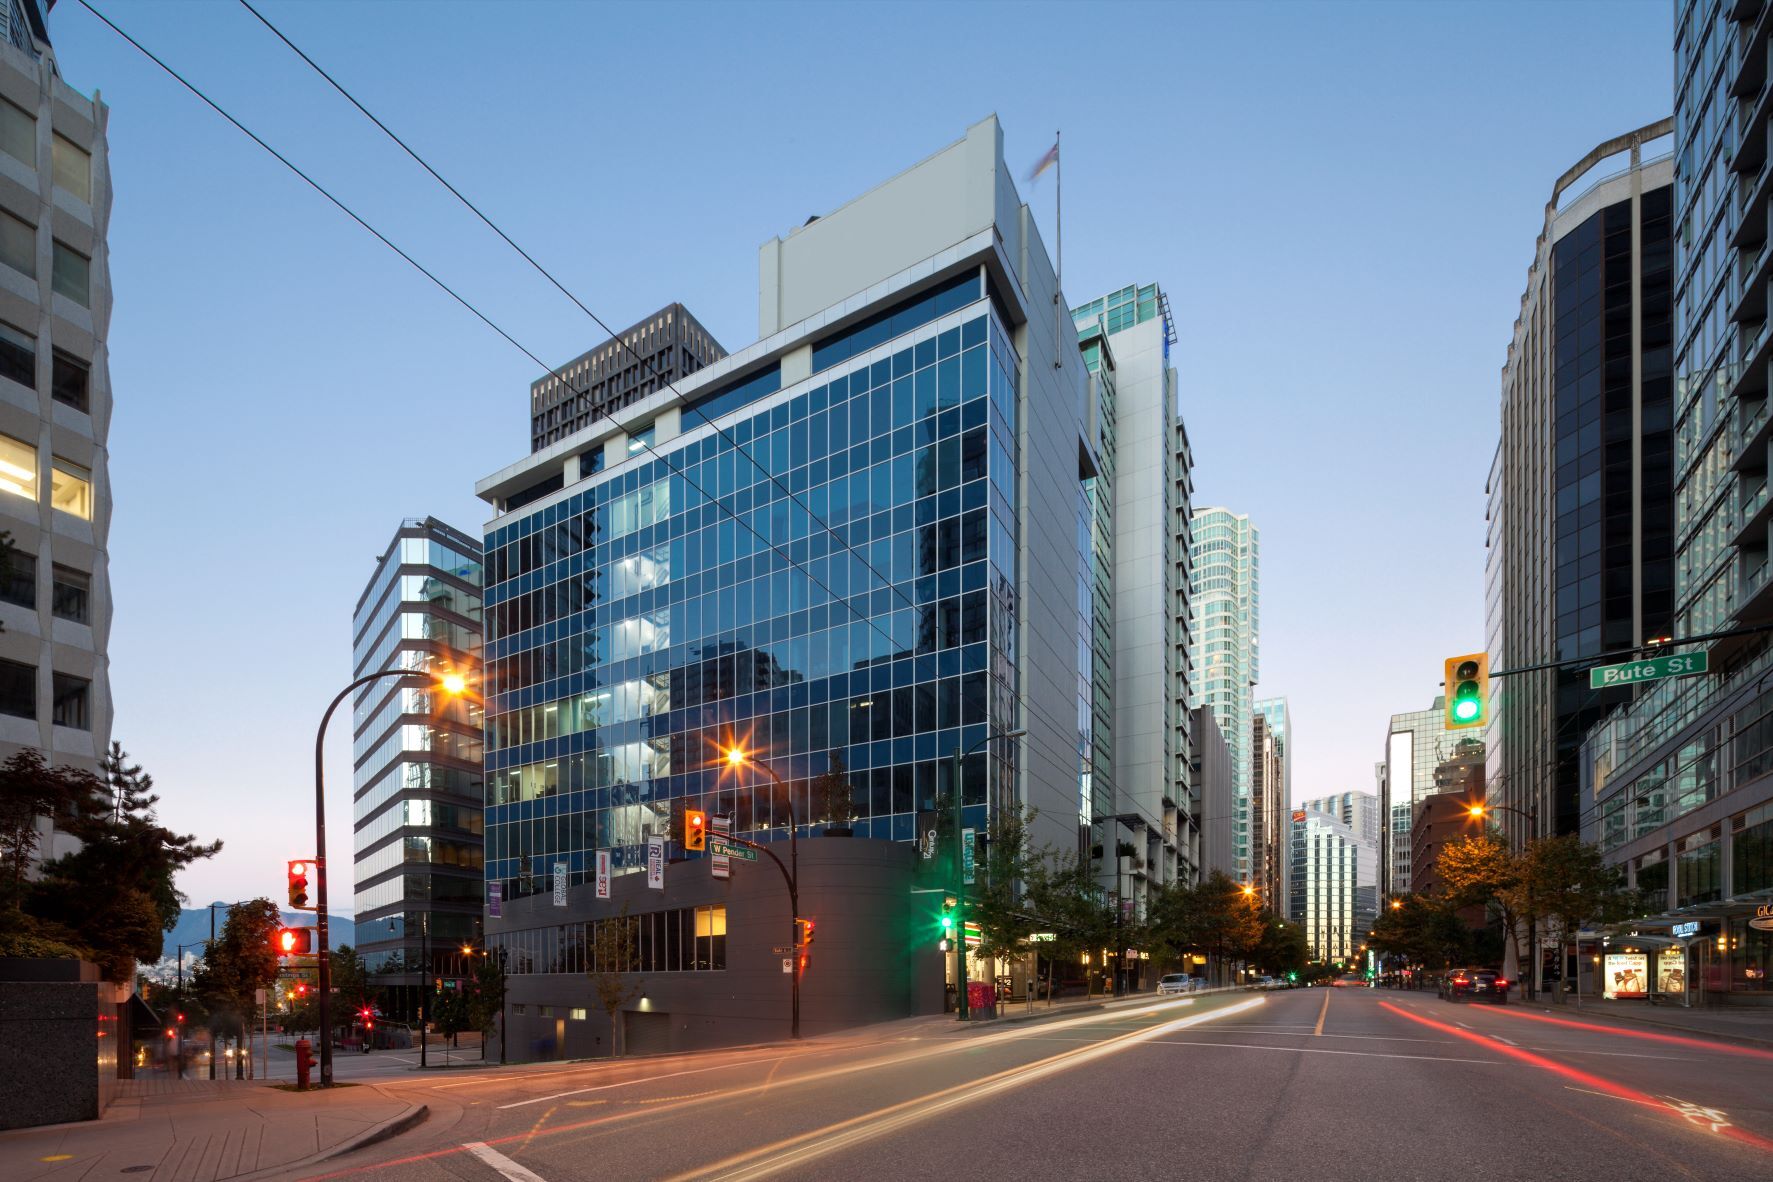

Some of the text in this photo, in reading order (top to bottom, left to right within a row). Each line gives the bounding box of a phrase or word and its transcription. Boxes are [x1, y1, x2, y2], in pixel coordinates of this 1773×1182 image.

[1604, 657, 1693, 683] Bute St
[713, 844, 754, 859] W Pender St
